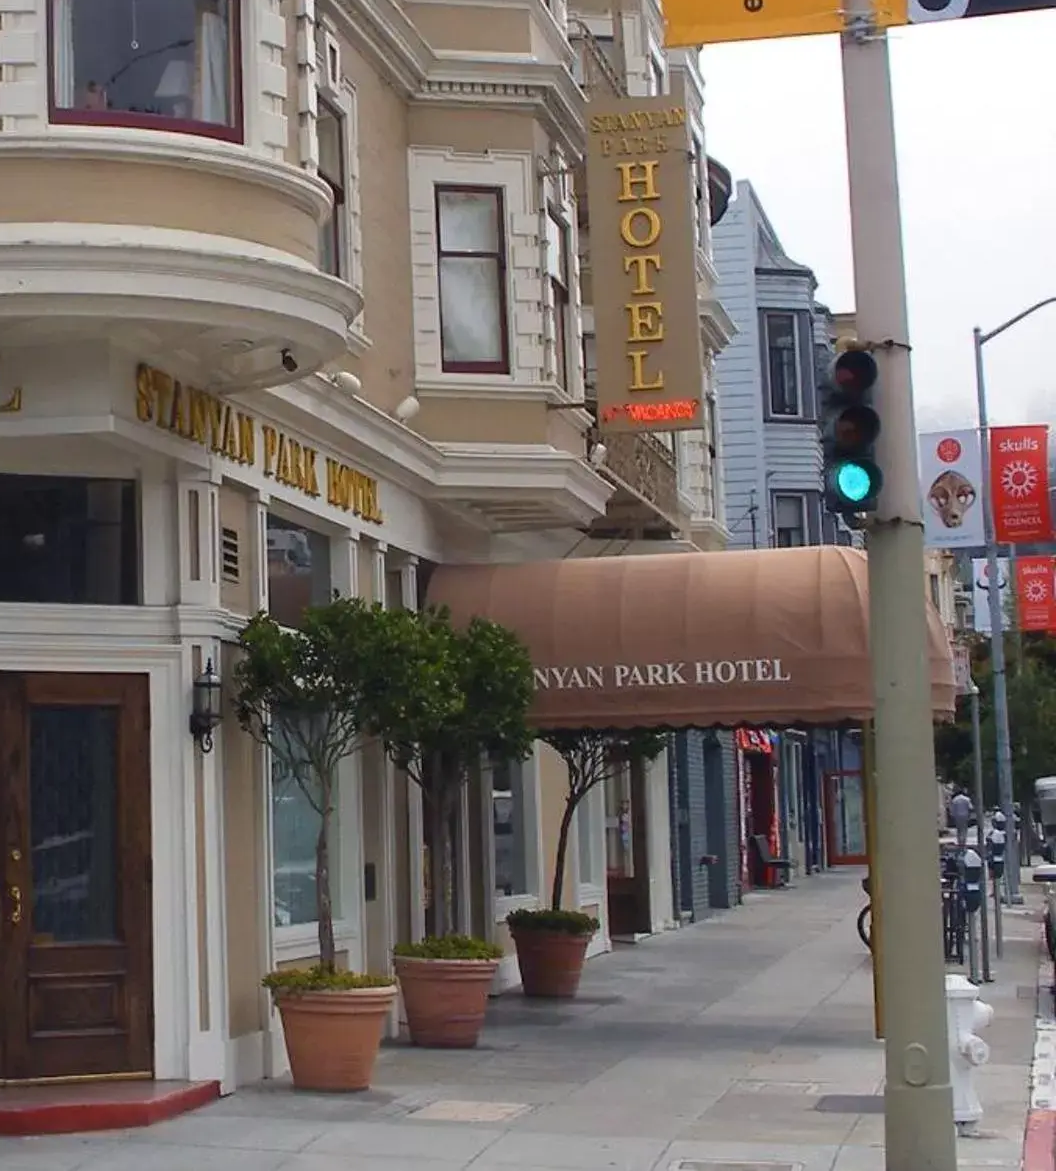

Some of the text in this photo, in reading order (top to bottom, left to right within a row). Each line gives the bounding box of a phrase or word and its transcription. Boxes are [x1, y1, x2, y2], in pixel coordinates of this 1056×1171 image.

[615, 160, 665, 391] HOTEL
[135, 362, 384, 525] STANYAN PARK HOTEL
[998, 437, 1039, 453] skulls
[614, 662, 687, 687] PARK
[695, 658, 791, 684] HOTEL
